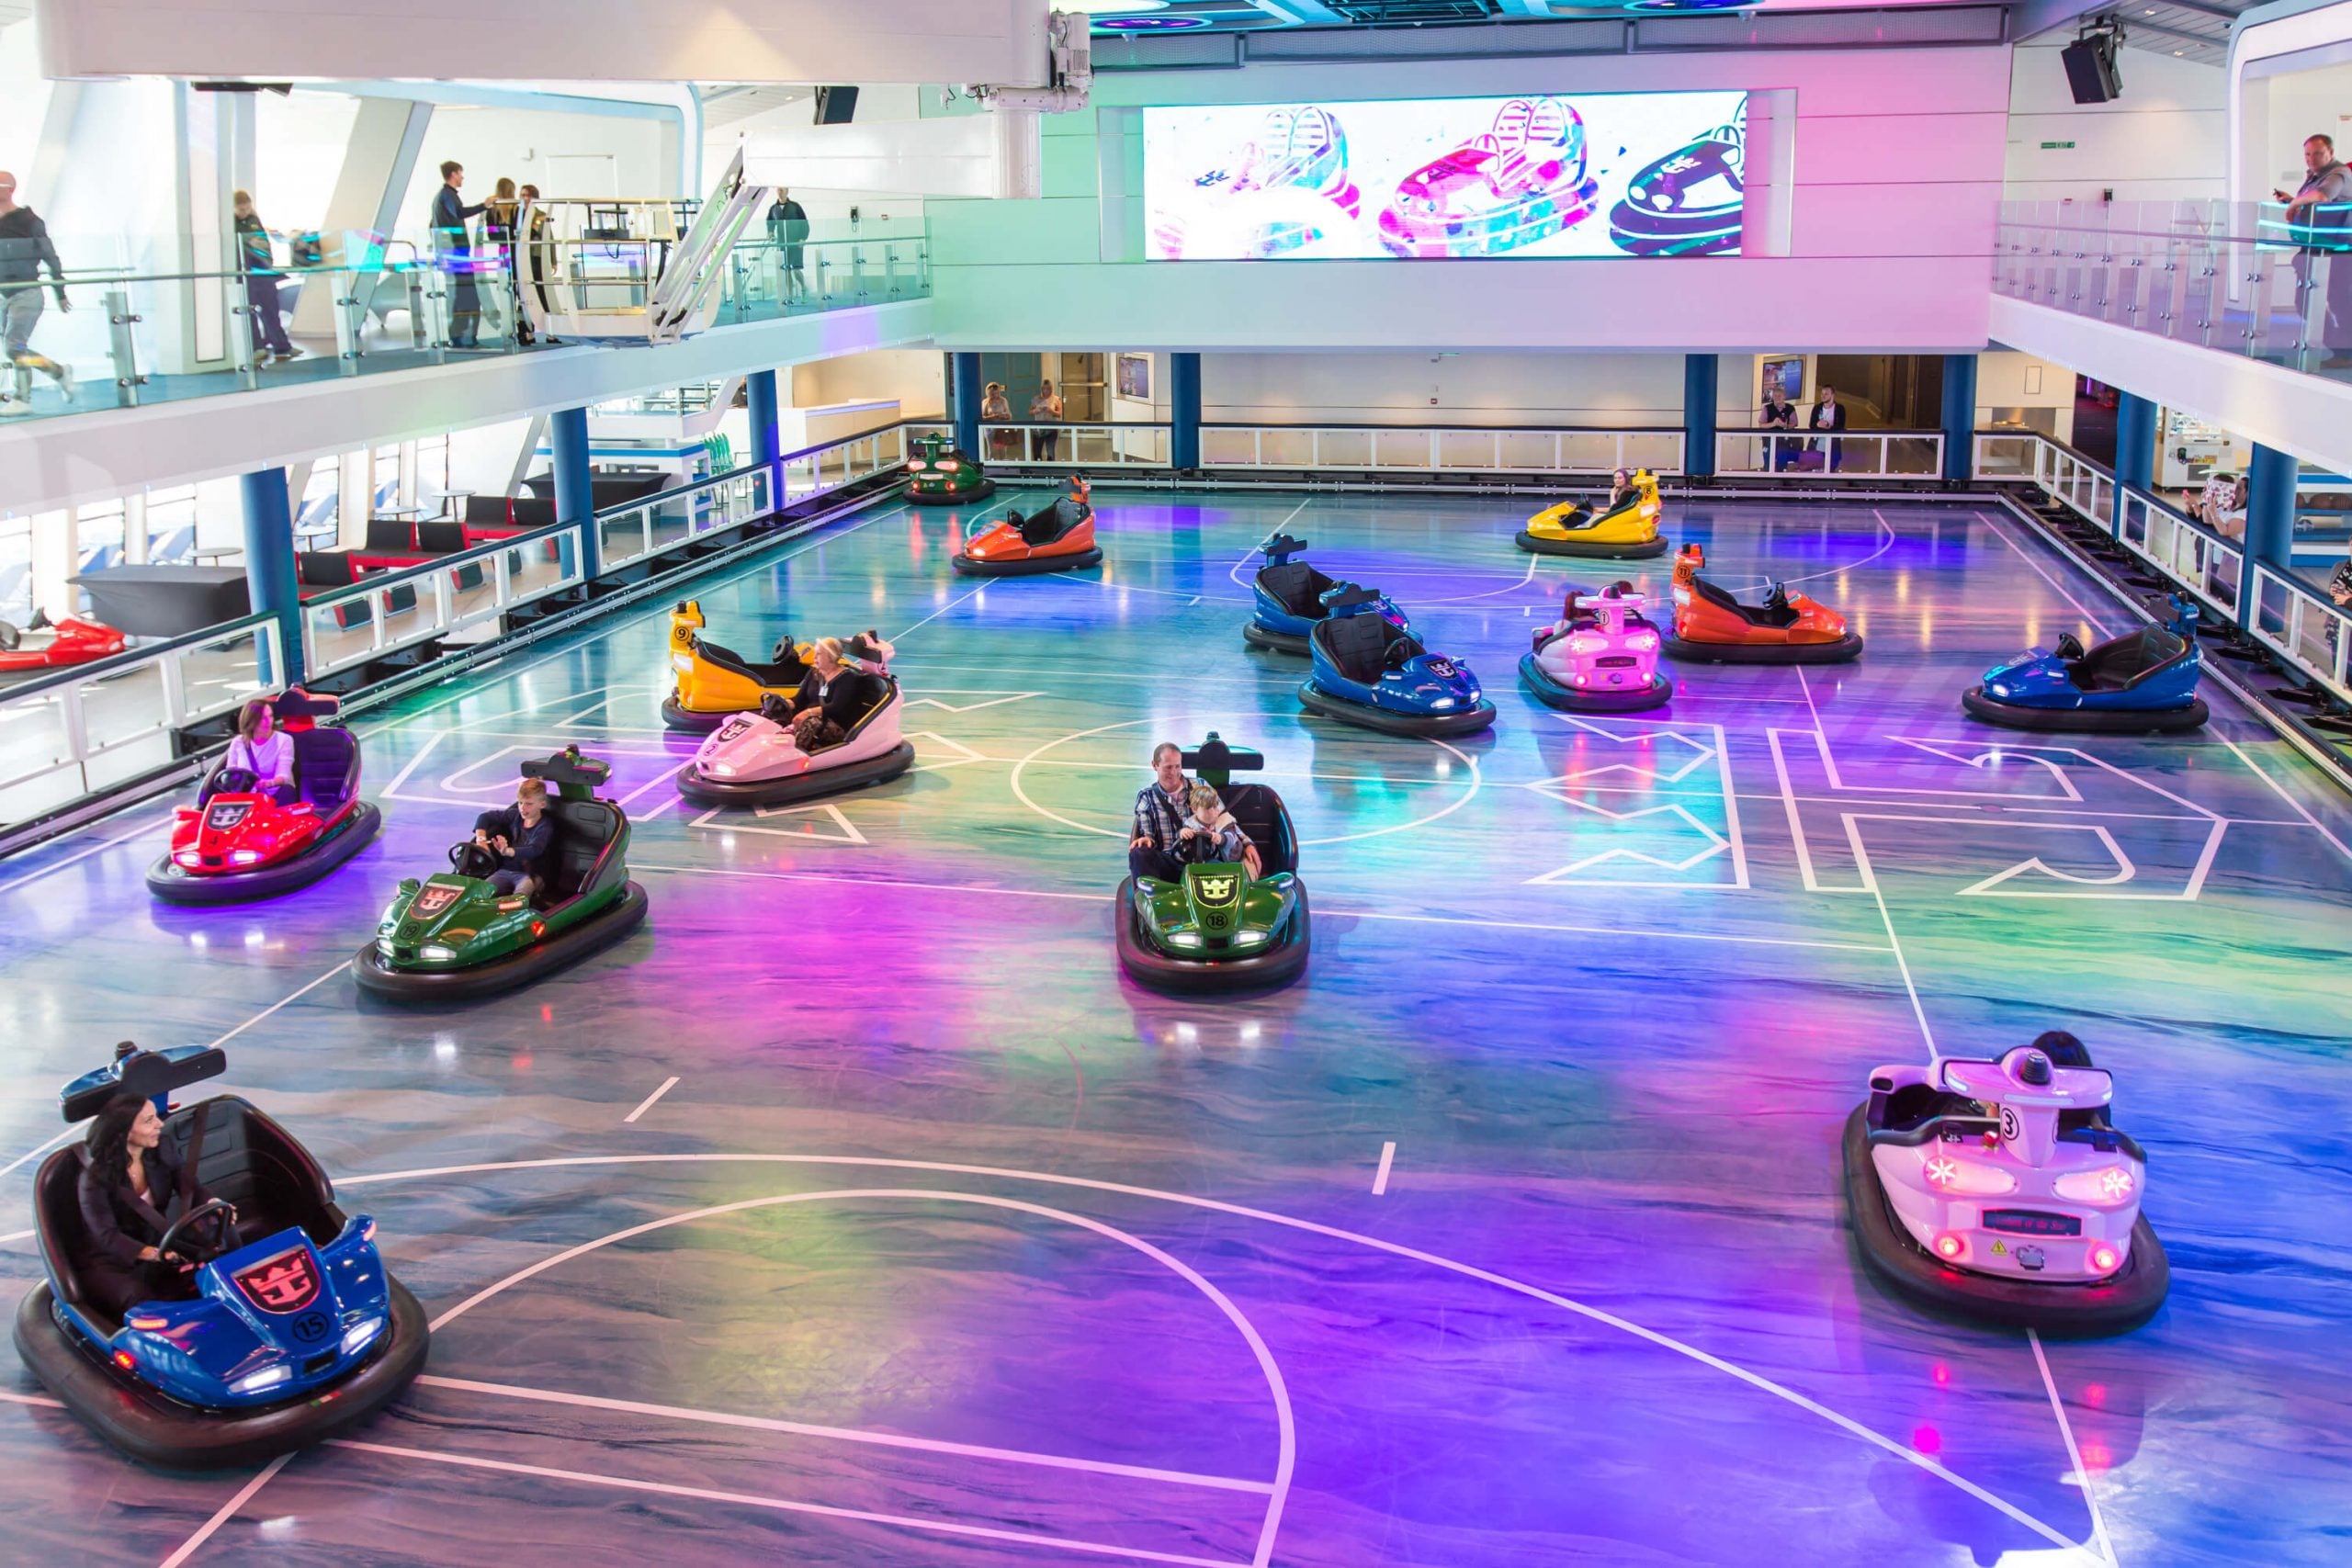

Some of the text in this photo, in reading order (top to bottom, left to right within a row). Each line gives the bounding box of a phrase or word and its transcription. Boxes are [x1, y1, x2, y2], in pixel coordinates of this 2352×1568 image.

[678, 628, 686, 638] 9
[1209, 915, 1225, 927] 18
[2004, 1112, 2013, 1135] 3
[297, 1314, 325, 1338] 15
